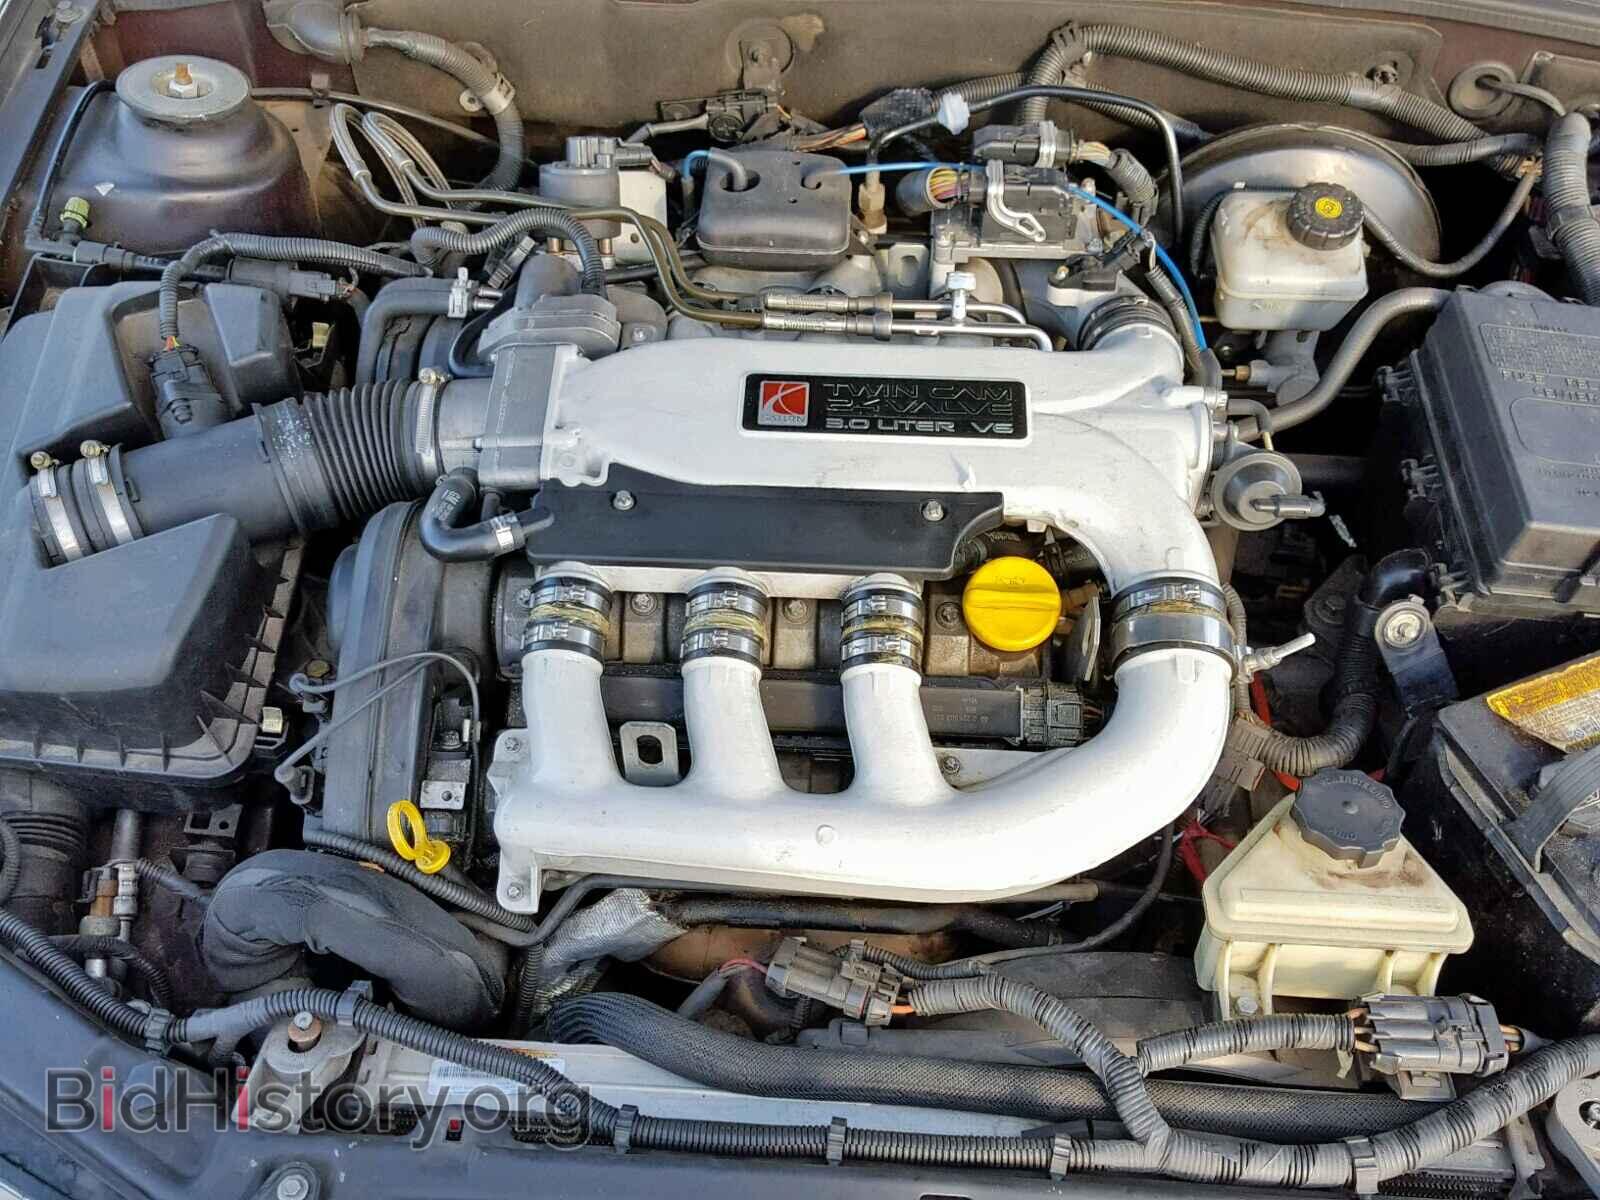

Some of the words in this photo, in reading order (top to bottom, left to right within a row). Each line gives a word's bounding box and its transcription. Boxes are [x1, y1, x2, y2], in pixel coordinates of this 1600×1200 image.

[822, 383, 919, 399] TWIN
[929, 385, 1013, 401] CAM
[886, 399, 1013, 416] VALVE
[825, 417, 870, 430] 3.0
[877, 419, 956, 432] LITER
[970, 421, 1014, 434] V6
